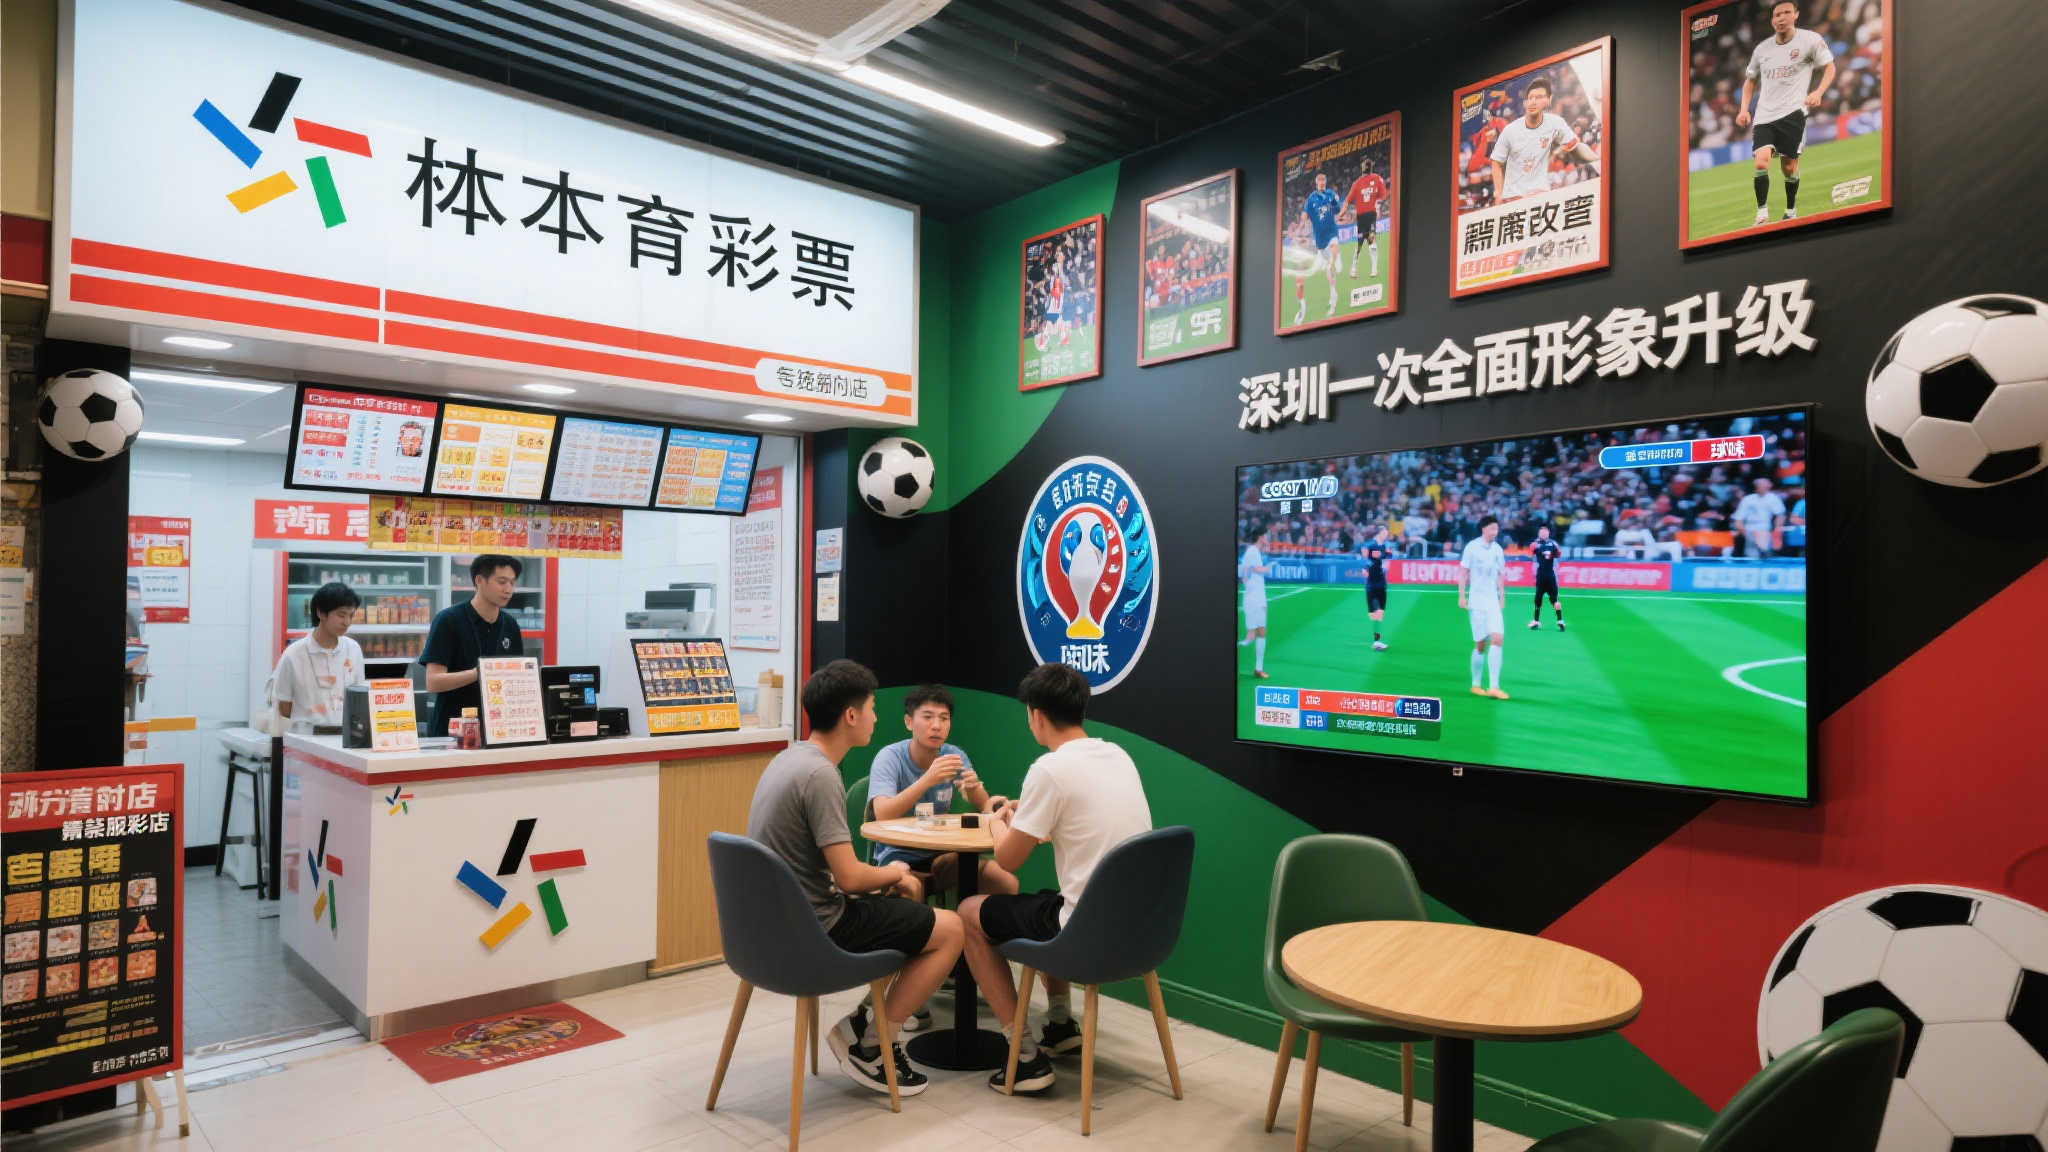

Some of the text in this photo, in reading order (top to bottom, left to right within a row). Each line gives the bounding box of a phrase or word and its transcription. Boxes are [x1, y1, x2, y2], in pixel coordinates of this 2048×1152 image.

[1237, 278, 1817, 430] 深圳一次全面形象升级
